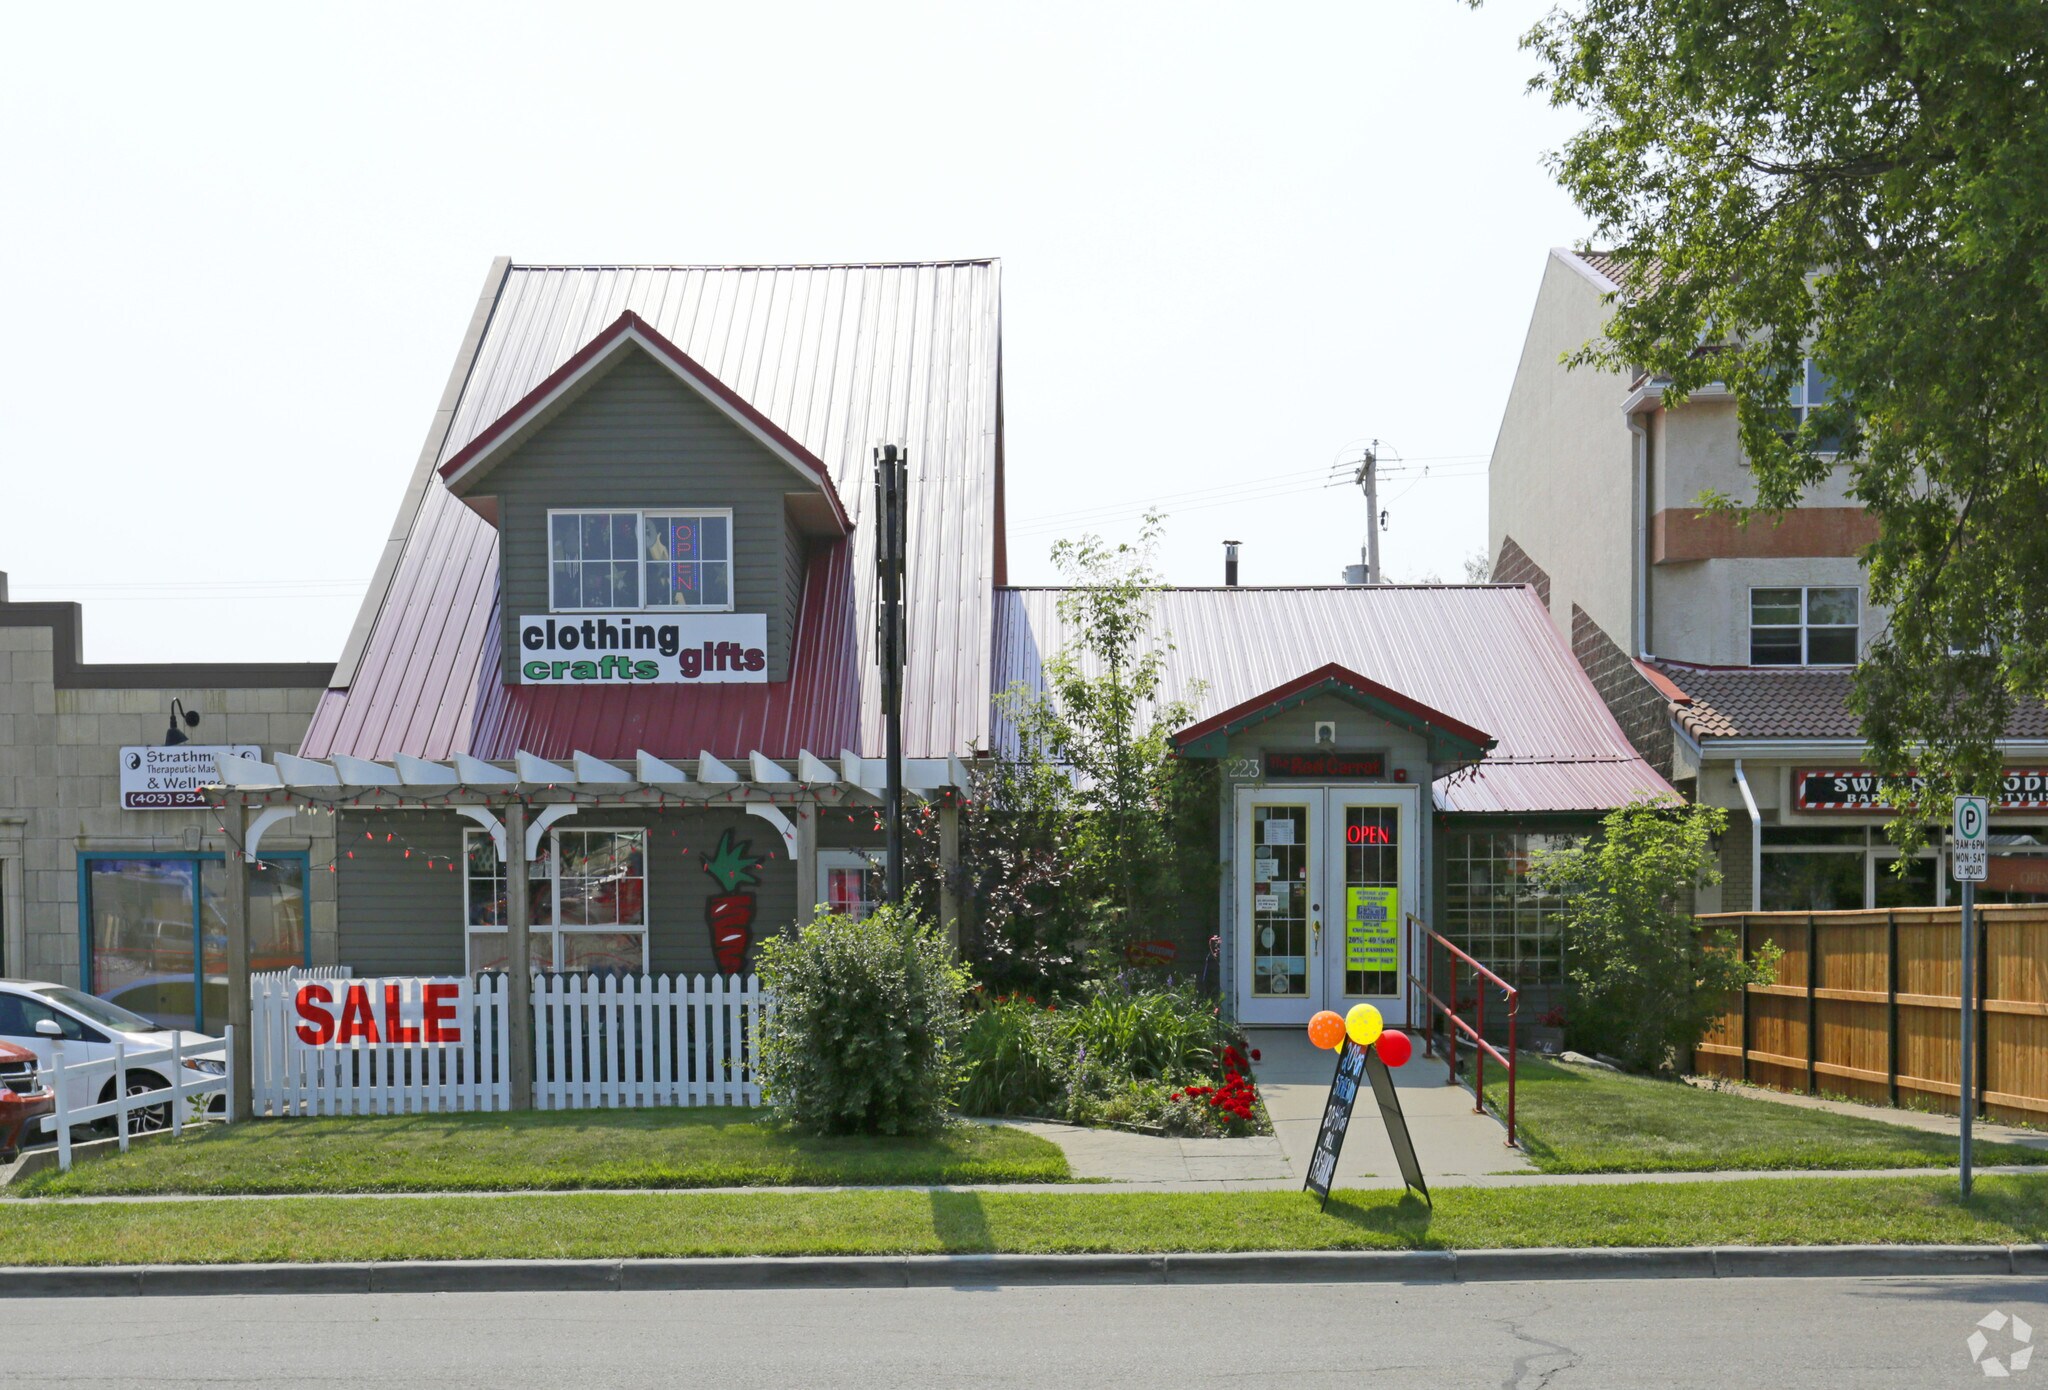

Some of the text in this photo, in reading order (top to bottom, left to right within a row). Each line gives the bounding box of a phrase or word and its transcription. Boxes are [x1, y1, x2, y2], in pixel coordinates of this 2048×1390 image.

[676, 525, 692, 590] OPEN
[522, 618, 679, 656] clothing
[523, 655, 659, 679] crafts
[146, 750, 215, 763] Strathm
[1290, 756, 1325, 775] Red
[1327, 755, 1381, 776] Carrot
[147, 764, 196, 776] Therapeutic
[1229, 759, 1260, 778] 223
[147, 777, 160, 789] &
[130, 794, 172, 806] (403)
[1966, 810, 1975, 830] P
[1347, 825, 1390, 844] OPEN
[1965, 865, 1983, 875] HOUR
[295, 984, 461, 1045] SALE
